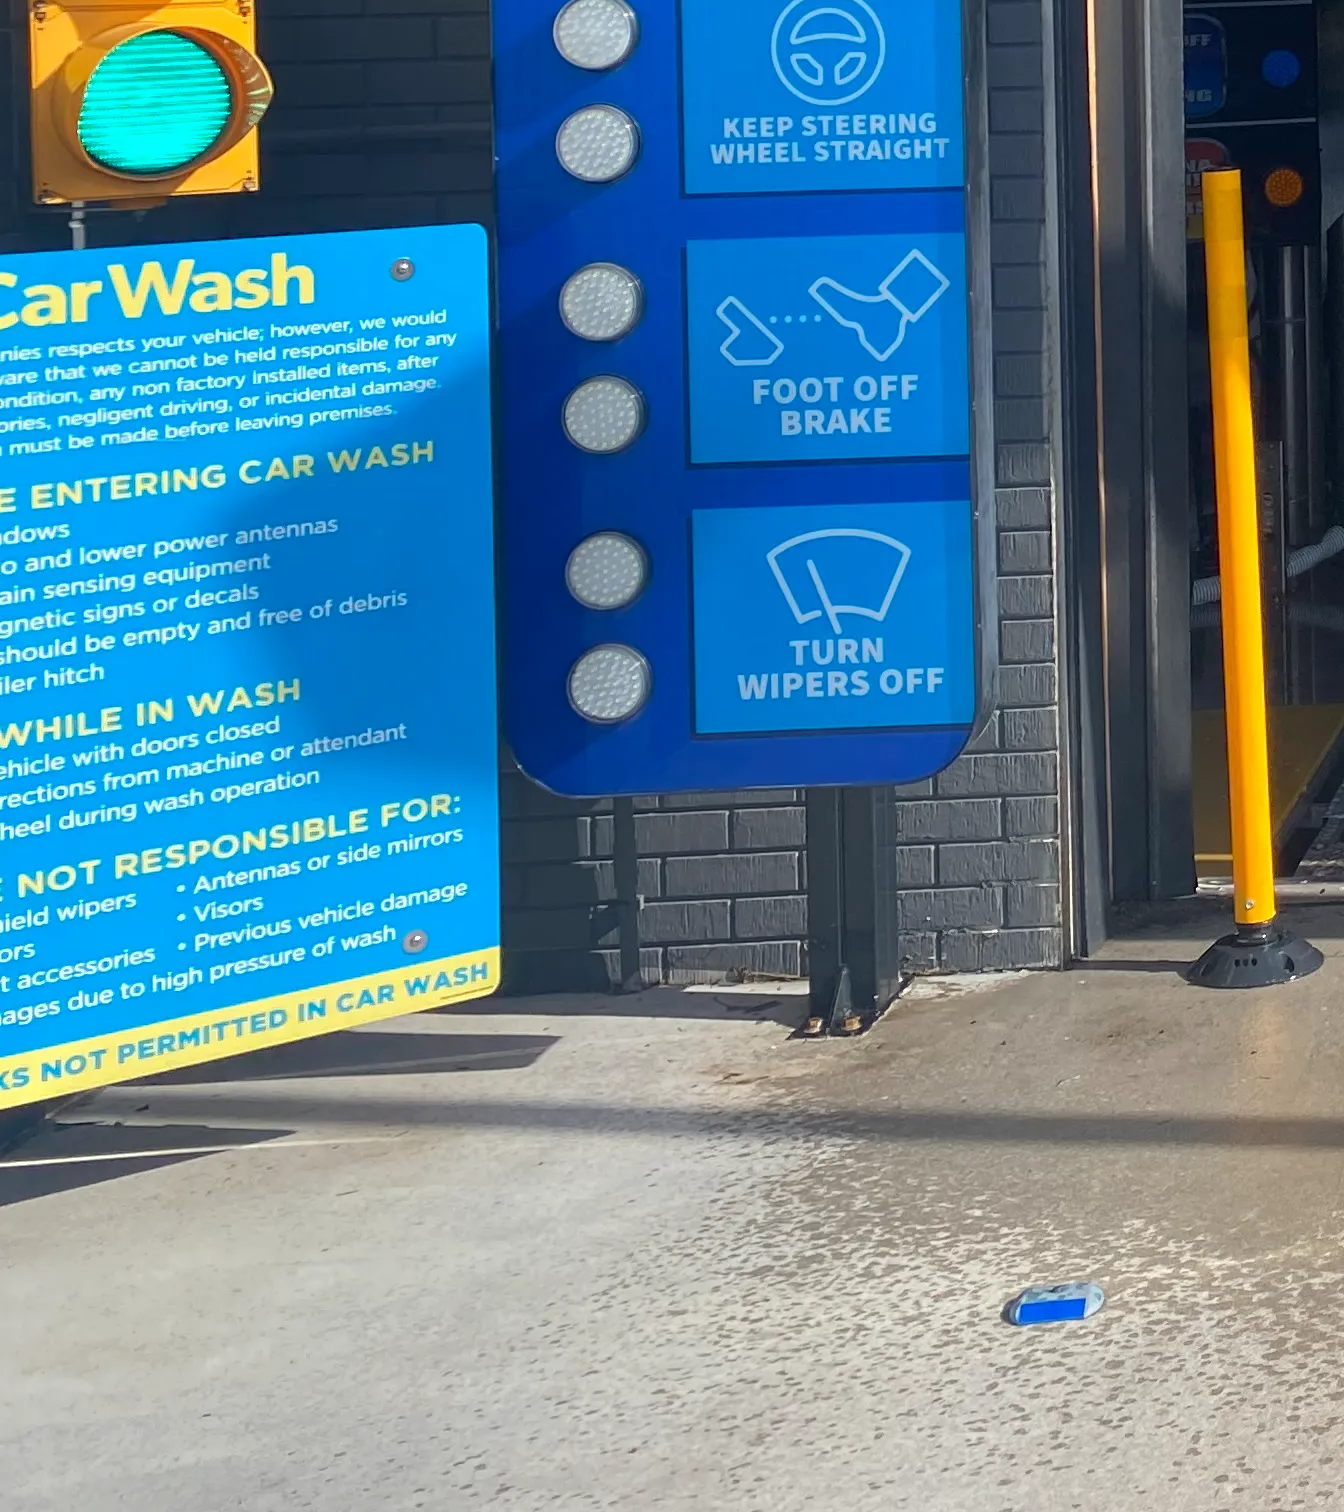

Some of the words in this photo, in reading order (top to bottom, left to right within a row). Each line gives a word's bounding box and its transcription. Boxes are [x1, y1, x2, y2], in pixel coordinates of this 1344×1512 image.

[723, 117, 793, 138] KEEP
[801, 113, 937, 136] STEERING
[710, 143, 806, 164] WHEEL
[814, 138, 949, 161] STRAIGHT
[45, 364, 85, 382] that
[92, 361, 122, 376] we
[129, 355, 197, 374] cannot
[204, 352, 228, 367] be
[235, 348, 276, 363] held
[283, 338, 388, 360] responsible
[394, 334, 420, 348] for
[425, 332, 456, 347] any
[49, 338, 135, 358] respects
[142, 335, 186, 352] your
[192, 326, 264, 346] vehicle;
[270, 320, 353, 339] however,
[359, 317, 386, 330] we
[392, 309, 447, 328] would
[58, 405, 153, 428] negligent
[160, 400, 232, 417] driving,
[239, 395, 259, 408] or
[265, 383, 356, 405] incidental
[362, 378, 441, 396] damage.
[90, 386, 125, 402] any
[132, 380, 170, 397] non
[177, 373, 245, 392] factory
[253, 364, 330, 384] installed
[337, 360, 391, 376] items,
[397, 355, 439, 371] after
[753, 376, 843, 405] FOOT
[854, 374, 918, 400] OFF
[9, 437, 61, 456] must
[68, 434, 94, 449] be
[101, 428, 158, 445] made
[165, 420, 229, 439] before
[236, 412, 303, 431] leaving
[309, 404, 397, 426] premises.
[781, 407, 892, 436] BRAKE
[31, 464, 226, 509] ENTERING
[239, 454, 314, 484] CAR
[327, 440, 433, 473] WASH
[25, 549, 72, 572] and
[79, 543, 146, 564] lower
[154, 533, 228, 558] power
[236, 518, 338, 544] antennas
[43, 574, 135, 599] sensing
[143, 554, 270, 585] equipment
[84, 602, 145, 624] signs
[153, 597, 178, 613] or
[185, 584, 259, 608] decals
[85, 634, 115, 653] be
[123, 622, 200, 647] empty
[207, 612, 251, 635] and
[259, 604, 303, 627] free
[309, 598, 333, 621] of
[339, 590, 407, 615] debris
[44, 663, 104, 688] hitch
[789, 637, 884, 666] TURN
[737, 670, 870, 700] WIPERS
[879, 667, 944, 694] OFF
[0, 707, 122, 749] WHILE
[137, 698, 173, 727] IN
[187, 678, 300, 717] WASH
[73, 743, 124, 766] with
[131, 732, 199, 757] doors
[206, 716, 279, 744] closed
[104, 769, 158, 791] from
[167, 750, 264, 780] machine
[270, 746, 294, 761] or
[301, 723, 407, 757] attendant
[59, 803, 136, 829] during
[144, 789, 204, 814] wash
[211, 770, 319, 803] operation
[18, 860, 101, 897] NOT
[115, 808, 368, 879] RESPONSIBLE
[381, 794, 460, 827] FOR:
[193, 860, 300, 894] Antennas
[307, 854, 330, 871] or
[337, 843, 381, 865] side
[388, 828, 463, 855] mirrors
[57, 893, 136, 920] wipers
[193, 896, 263, 922] Visors
[194, 918, 291, 952] Previous
[298, 901, 374, 929] vehicle
[381, 882, 468, 912] damage
[17, 948, 155, 989] accessories
[67, 989, 114, 1011] due
[120, 982, 145, 999] to
[152, 968, 203, 992] high
[210, 946, 305, 984] pressure
[312, 935, 335, 957] of
[341, 925, 396, 951] wash
[41, 1049, 107, 1081] NOT
[118, 1010, 287, 1064] PERMITTED
[298, 999, 326, 1021] IN
[336, 984, 394, 1012] CAR
[404, 962, 488, 996] WASH
